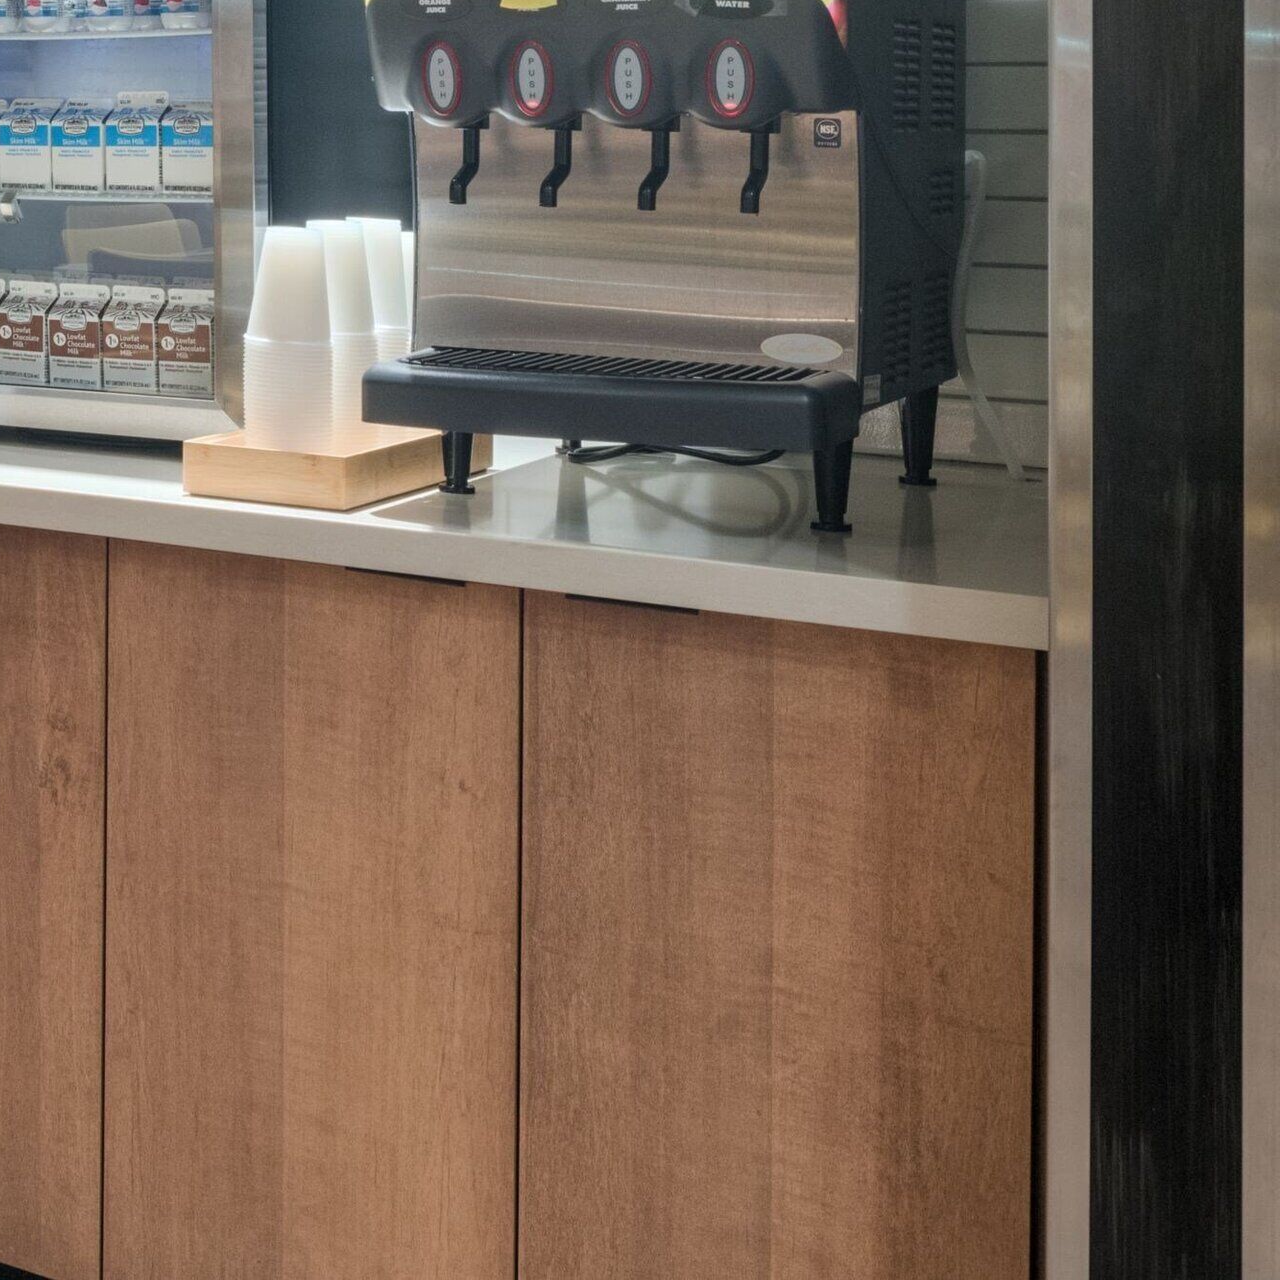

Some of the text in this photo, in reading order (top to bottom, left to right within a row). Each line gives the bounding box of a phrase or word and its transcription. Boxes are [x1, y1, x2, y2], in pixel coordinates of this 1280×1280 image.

[715, 0, 750, 8] WATER
[437, 58, 446, 98] PUSH
[528, 58, 536, 100] PUSH
[727, 56, 735, 100] PUSH
[820, 124, 836, 134] NSF
[12, 334, 39, 342] Chocolate
[176, 337, 196, 345] Lowfat
[67, 341, 95, 349] Chocolate
[120, 342, 149, 350] Chocolate
